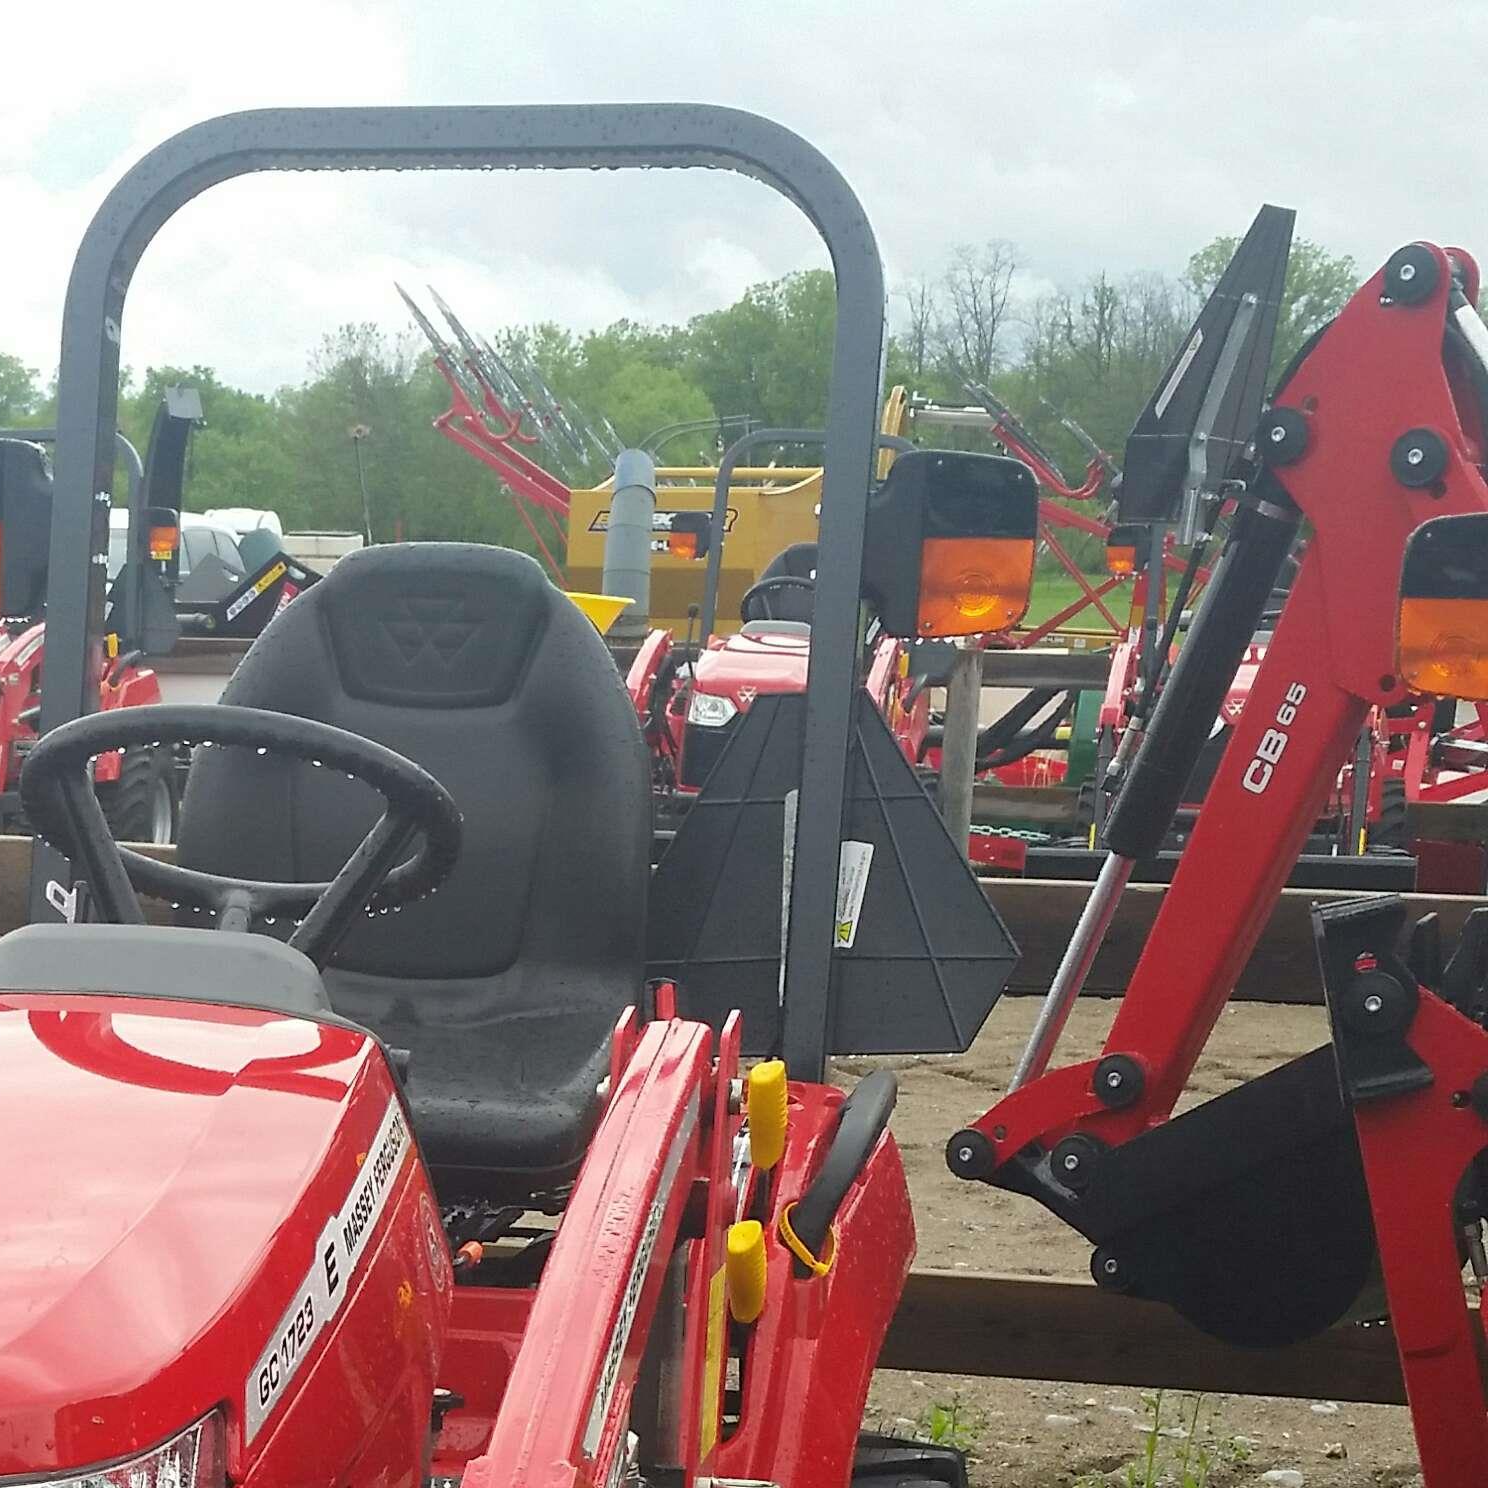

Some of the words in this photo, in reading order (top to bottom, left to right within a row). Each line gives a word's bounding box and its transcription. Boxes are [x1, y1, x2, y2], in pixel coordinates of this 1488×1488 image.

[1242, 728, 1289, 795] CB
[1275, 681, 1308, 727] 65
[258, 1348, 280, 1408] GC
[279, 1295, 315, 1372] 1723
[324, 1241, 340, 1298] E
[342, 1174, 376, 1257] MASSEY
